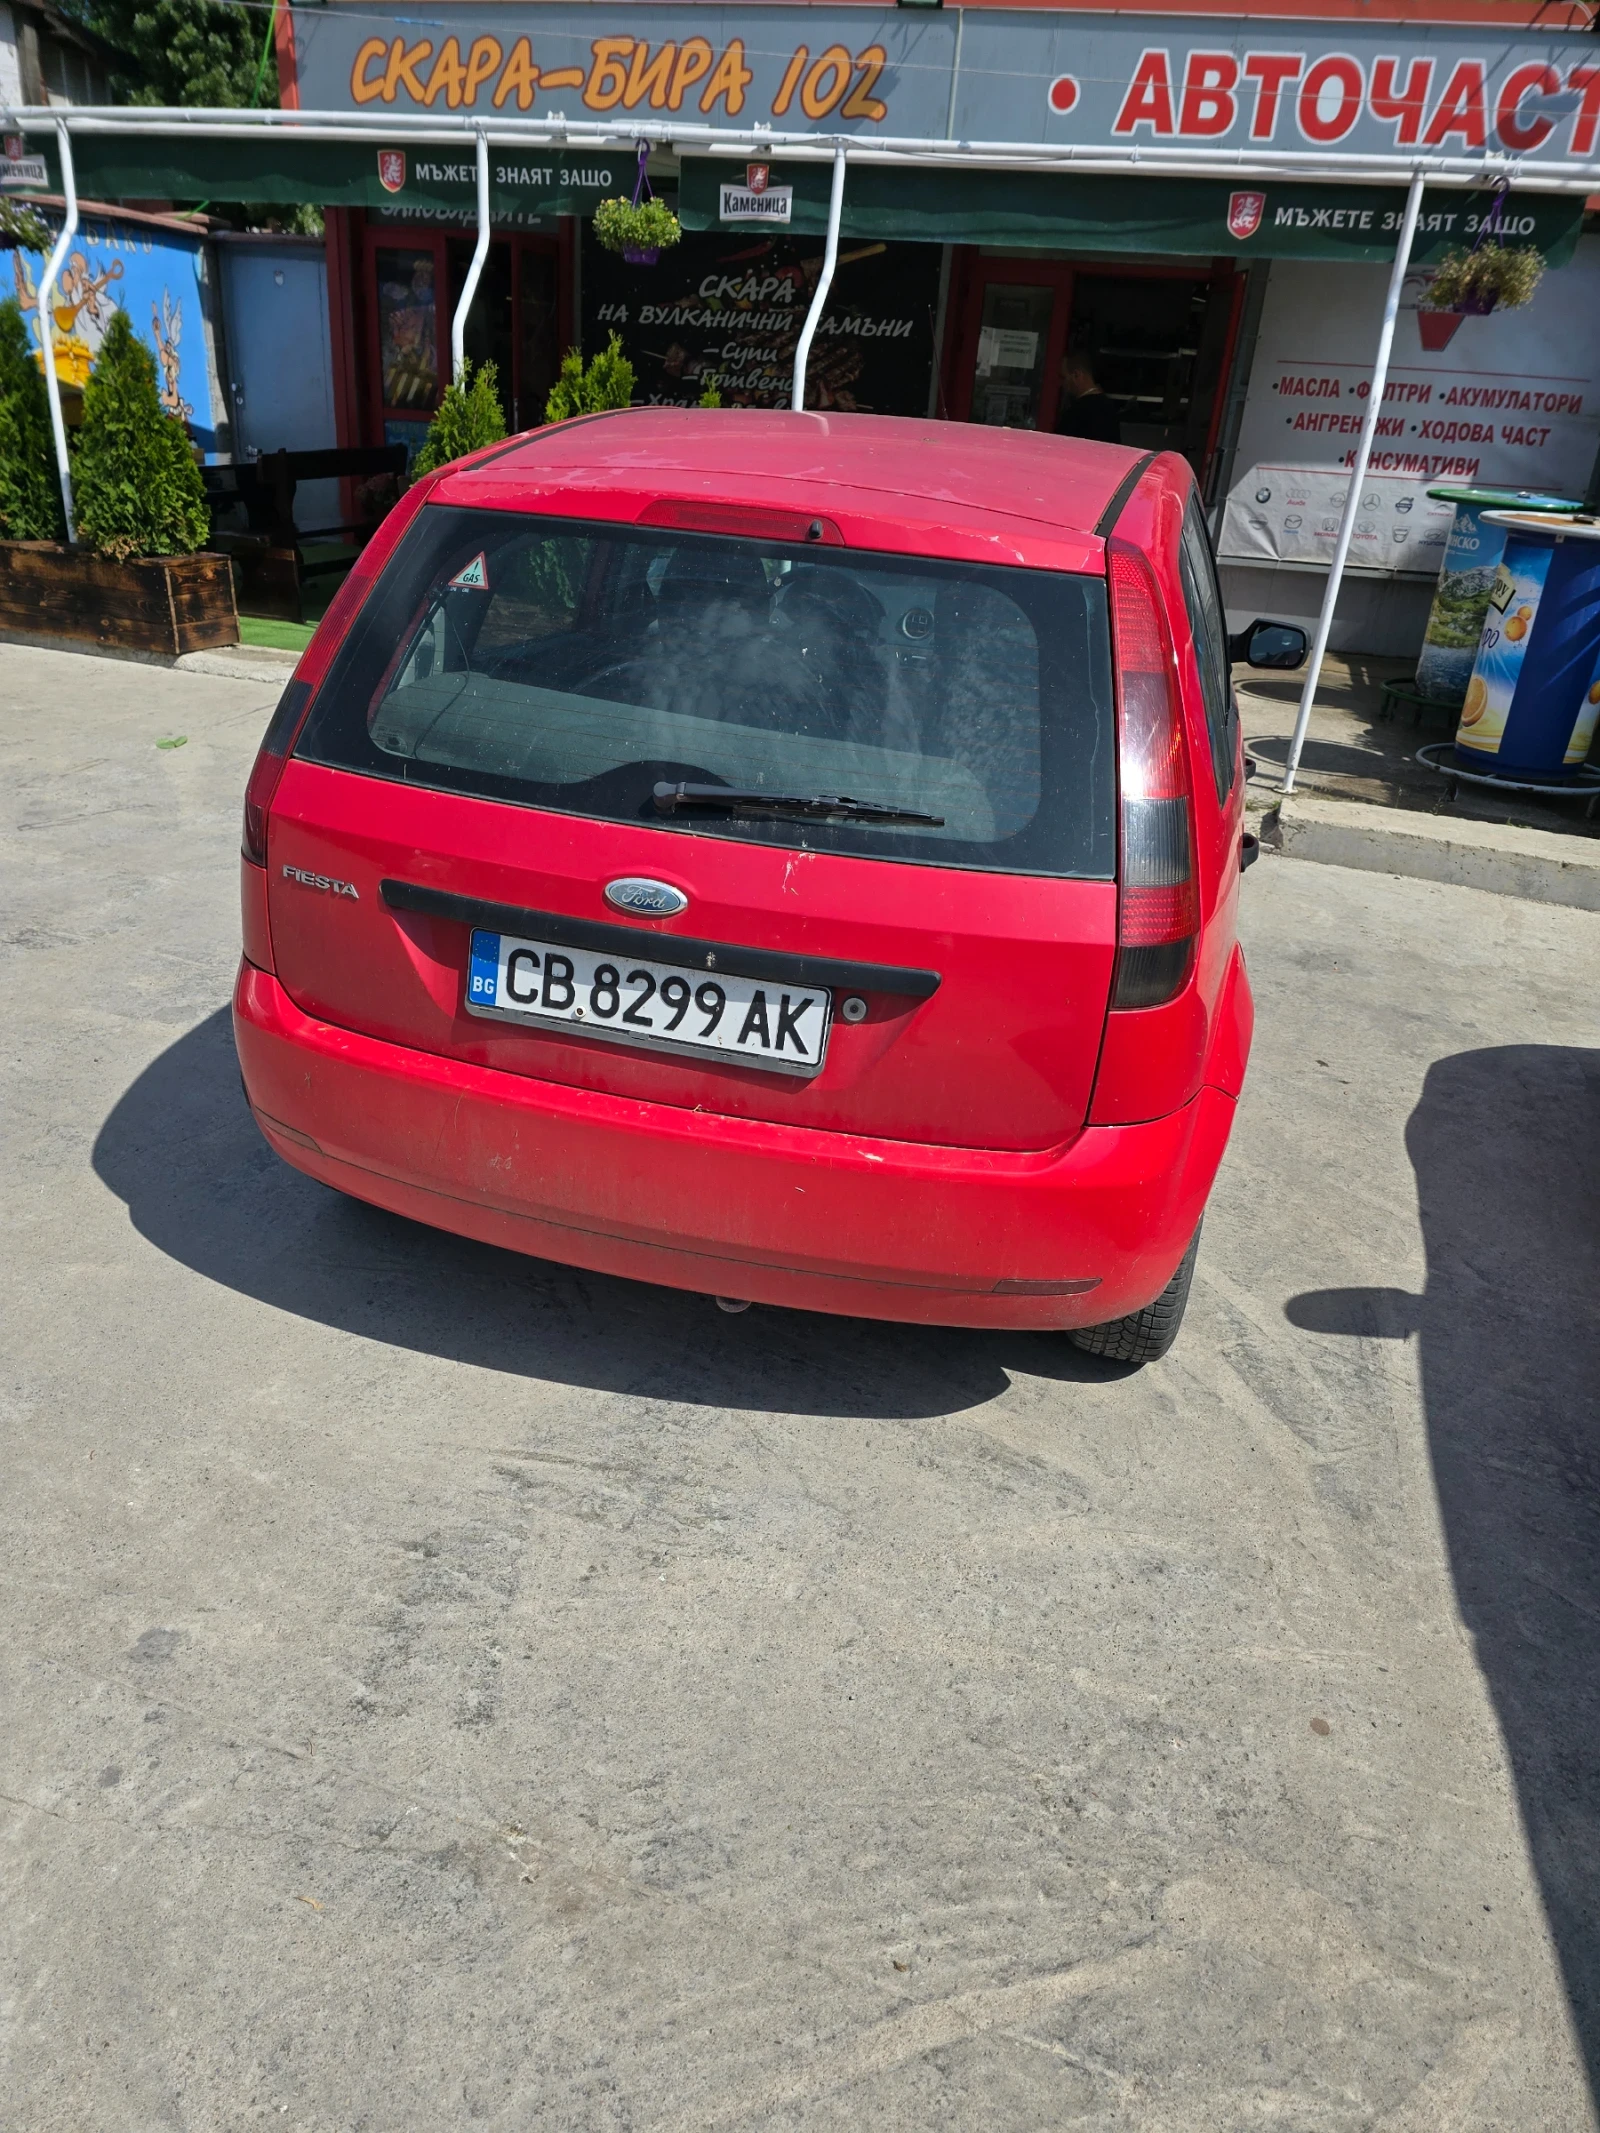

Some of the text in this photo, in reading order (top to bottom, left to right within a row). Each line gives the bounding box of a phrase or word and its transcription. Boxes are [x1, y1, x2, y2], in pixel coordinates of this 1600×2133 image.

[771, 43, 888, 122] 102
[415, 163, 613, 188] МЪЖЕТ ЗНАЯТ ЗАЩО
[723, 191, 788, 216] Каменица
[1274, 206, 1374, 231] МЪЖЕТЕ
[699, 275, 796, 303] СКАРА
[597, 303, 914, 338] НА ВУЛКАНИЧНИ АМЪНИ
[1279, 376, 1583, 415] МАСЛА ФЛТРИ АКУМУЛАТОРИ
[1292, 412, 1551, 447] АНГРЕНЖИ ХОДОВА ЧАСТ
[1344, 450, 1480, 477] КНСУМАТИВИ
[463, 574, 480, 583] GAS
[282, 864, 360, 899] FIESTA
[622, 884, 666, 910] Ford
[472, 976, 495, 995] BG
[589, 963, 727, 1038] 8299
